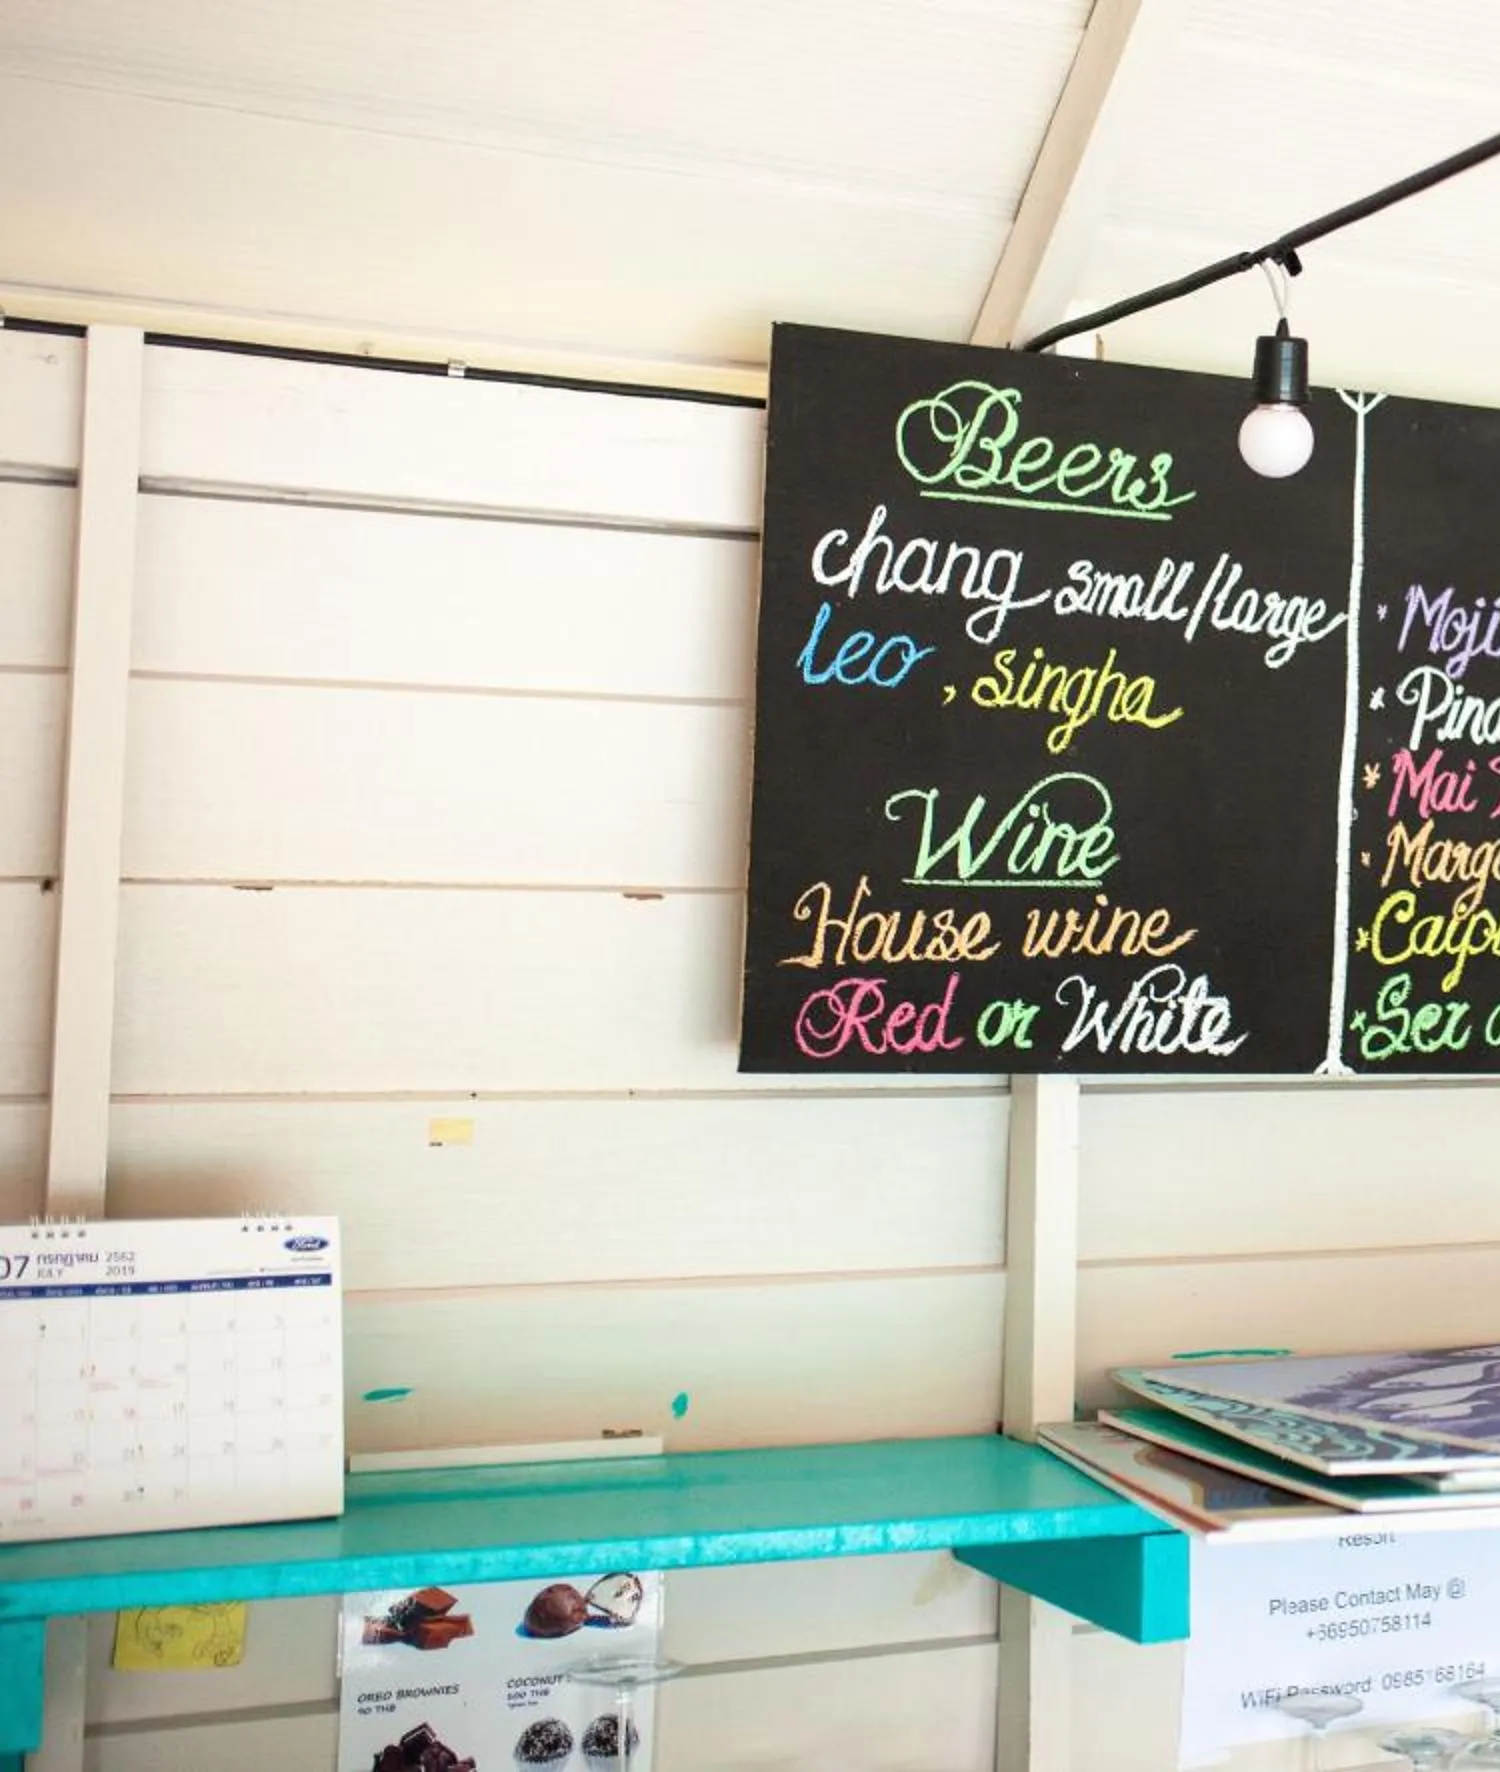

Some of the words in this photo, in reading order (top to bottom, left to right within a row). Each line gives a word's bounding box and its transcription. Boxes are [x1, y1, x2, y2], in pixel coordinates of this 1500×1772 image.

[896, 380, 1196, 511] Beers
[811, 505, 1054, 644] chang
[885, 771, 1121, 880] Wine
[1388, 748, 1478, 818] Mai
[778, 876, 1000, 969] House
[1021, 894, 1198, 959] wine
[794, 971, 965, 1060] Red
[976, 998, 1041, 1050] or
[1054, 963, 1251, 1058] White
[1361, 973, 1471, 1060] Sex
[1268, 1593, 1330, 1617] Please
[1334, 1586, 1402, 1610] Contact
[1405, 1582, 1442, 1602] May
[1446, 1576, 1467, 1600] @
